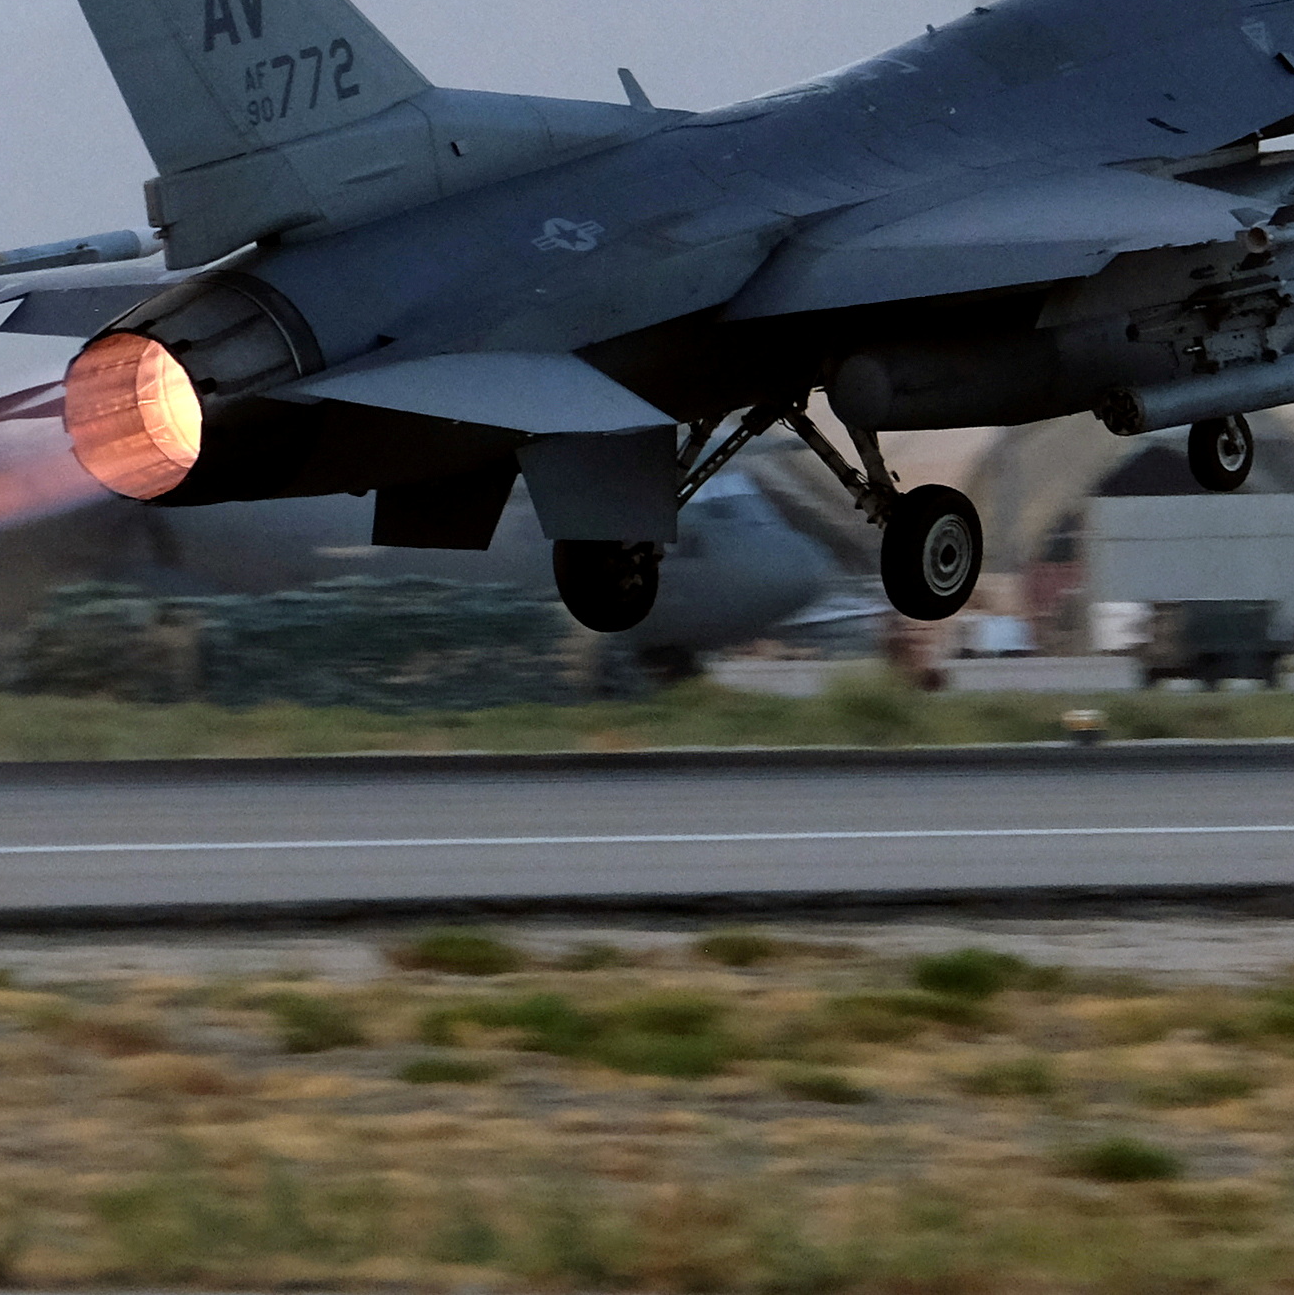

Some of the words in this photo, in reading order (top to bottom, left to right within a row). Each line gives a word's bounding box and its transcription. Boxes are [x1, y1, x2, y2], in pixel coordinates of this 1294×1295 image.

[245, 60, 267, 93] AF
[271, 37, 360, 119] 772
[246, 96, 275, 126] 90
